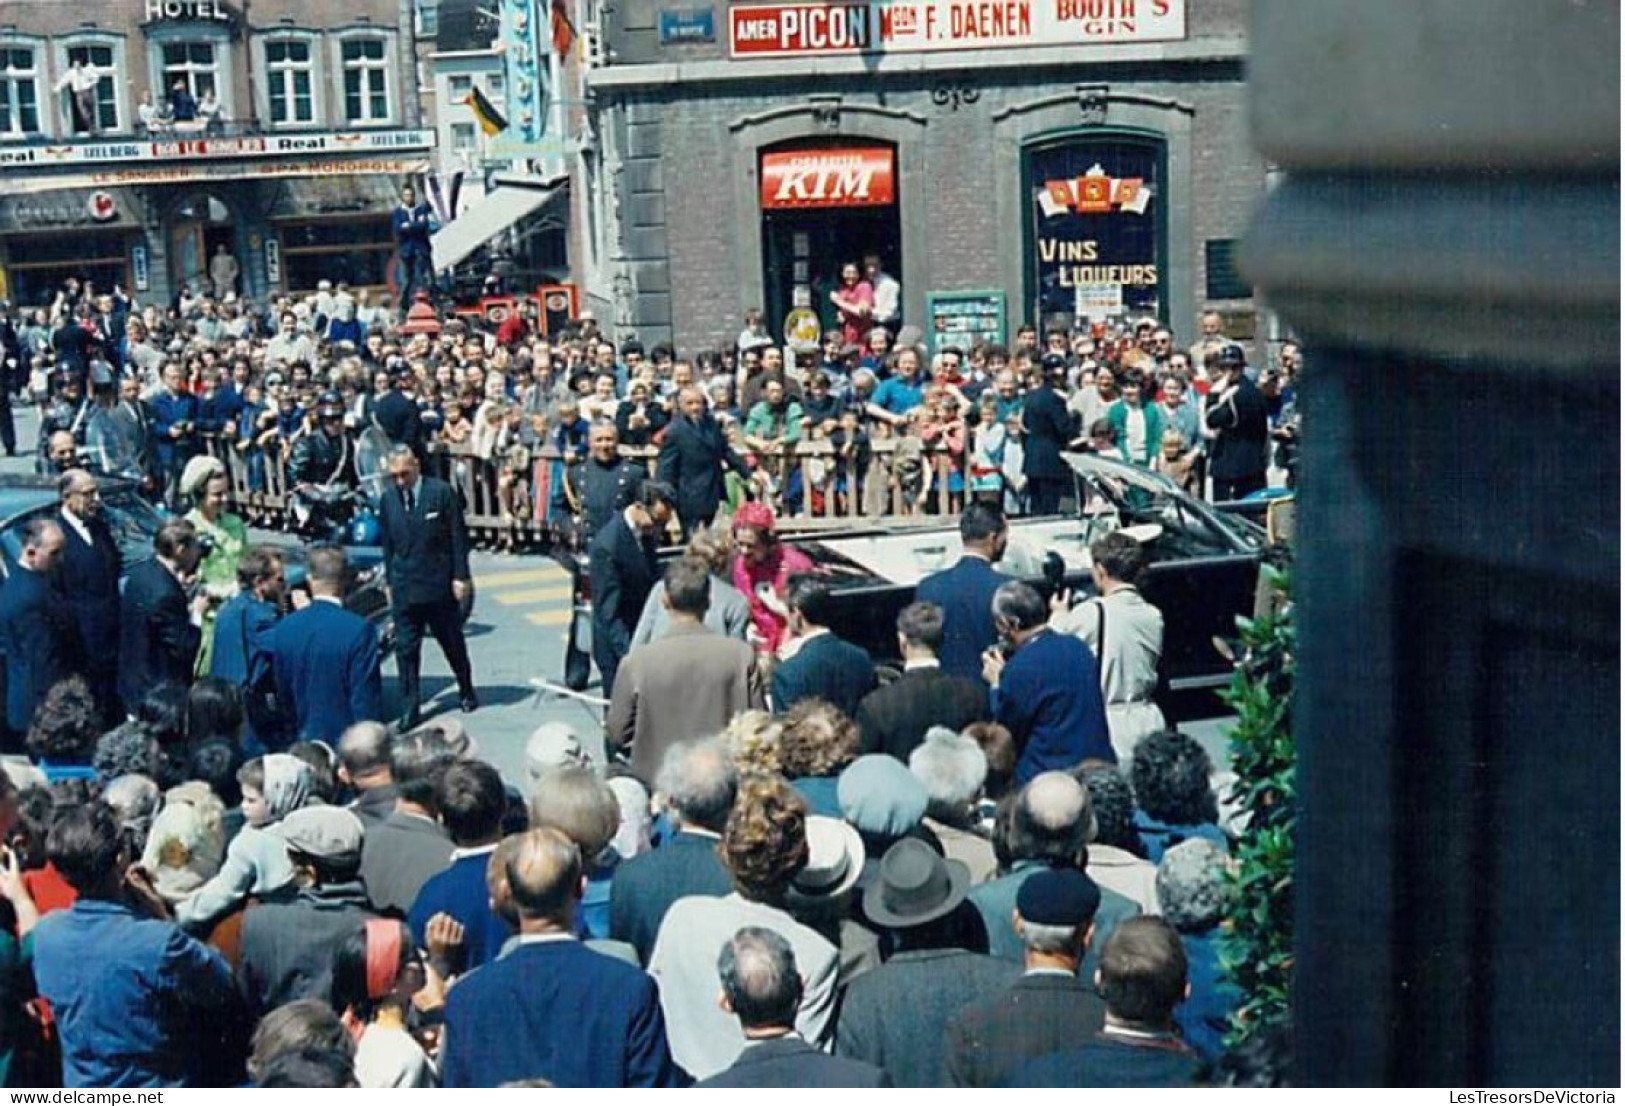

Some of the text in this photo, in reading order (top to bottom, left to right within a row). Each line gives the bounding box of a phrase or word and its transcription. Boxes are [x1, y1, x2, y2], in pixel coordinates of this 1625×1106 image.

[146, 0, 229, 21] HOTEL
[927, 6, 943, 40] F.
[951, 2, 1031, 39] DAENEN
[737, 7, 866, 49] AMER PICON
[1084, 21, 1135, 34] GIN
[278, 137, 326, 151] Real
[0, 150, 35, 163] eal
[774, 166, 874, 200] KIM
[1038, 238, 1099, 263] VINS
[1059, 264, 1158, 288] LIQUEURS
